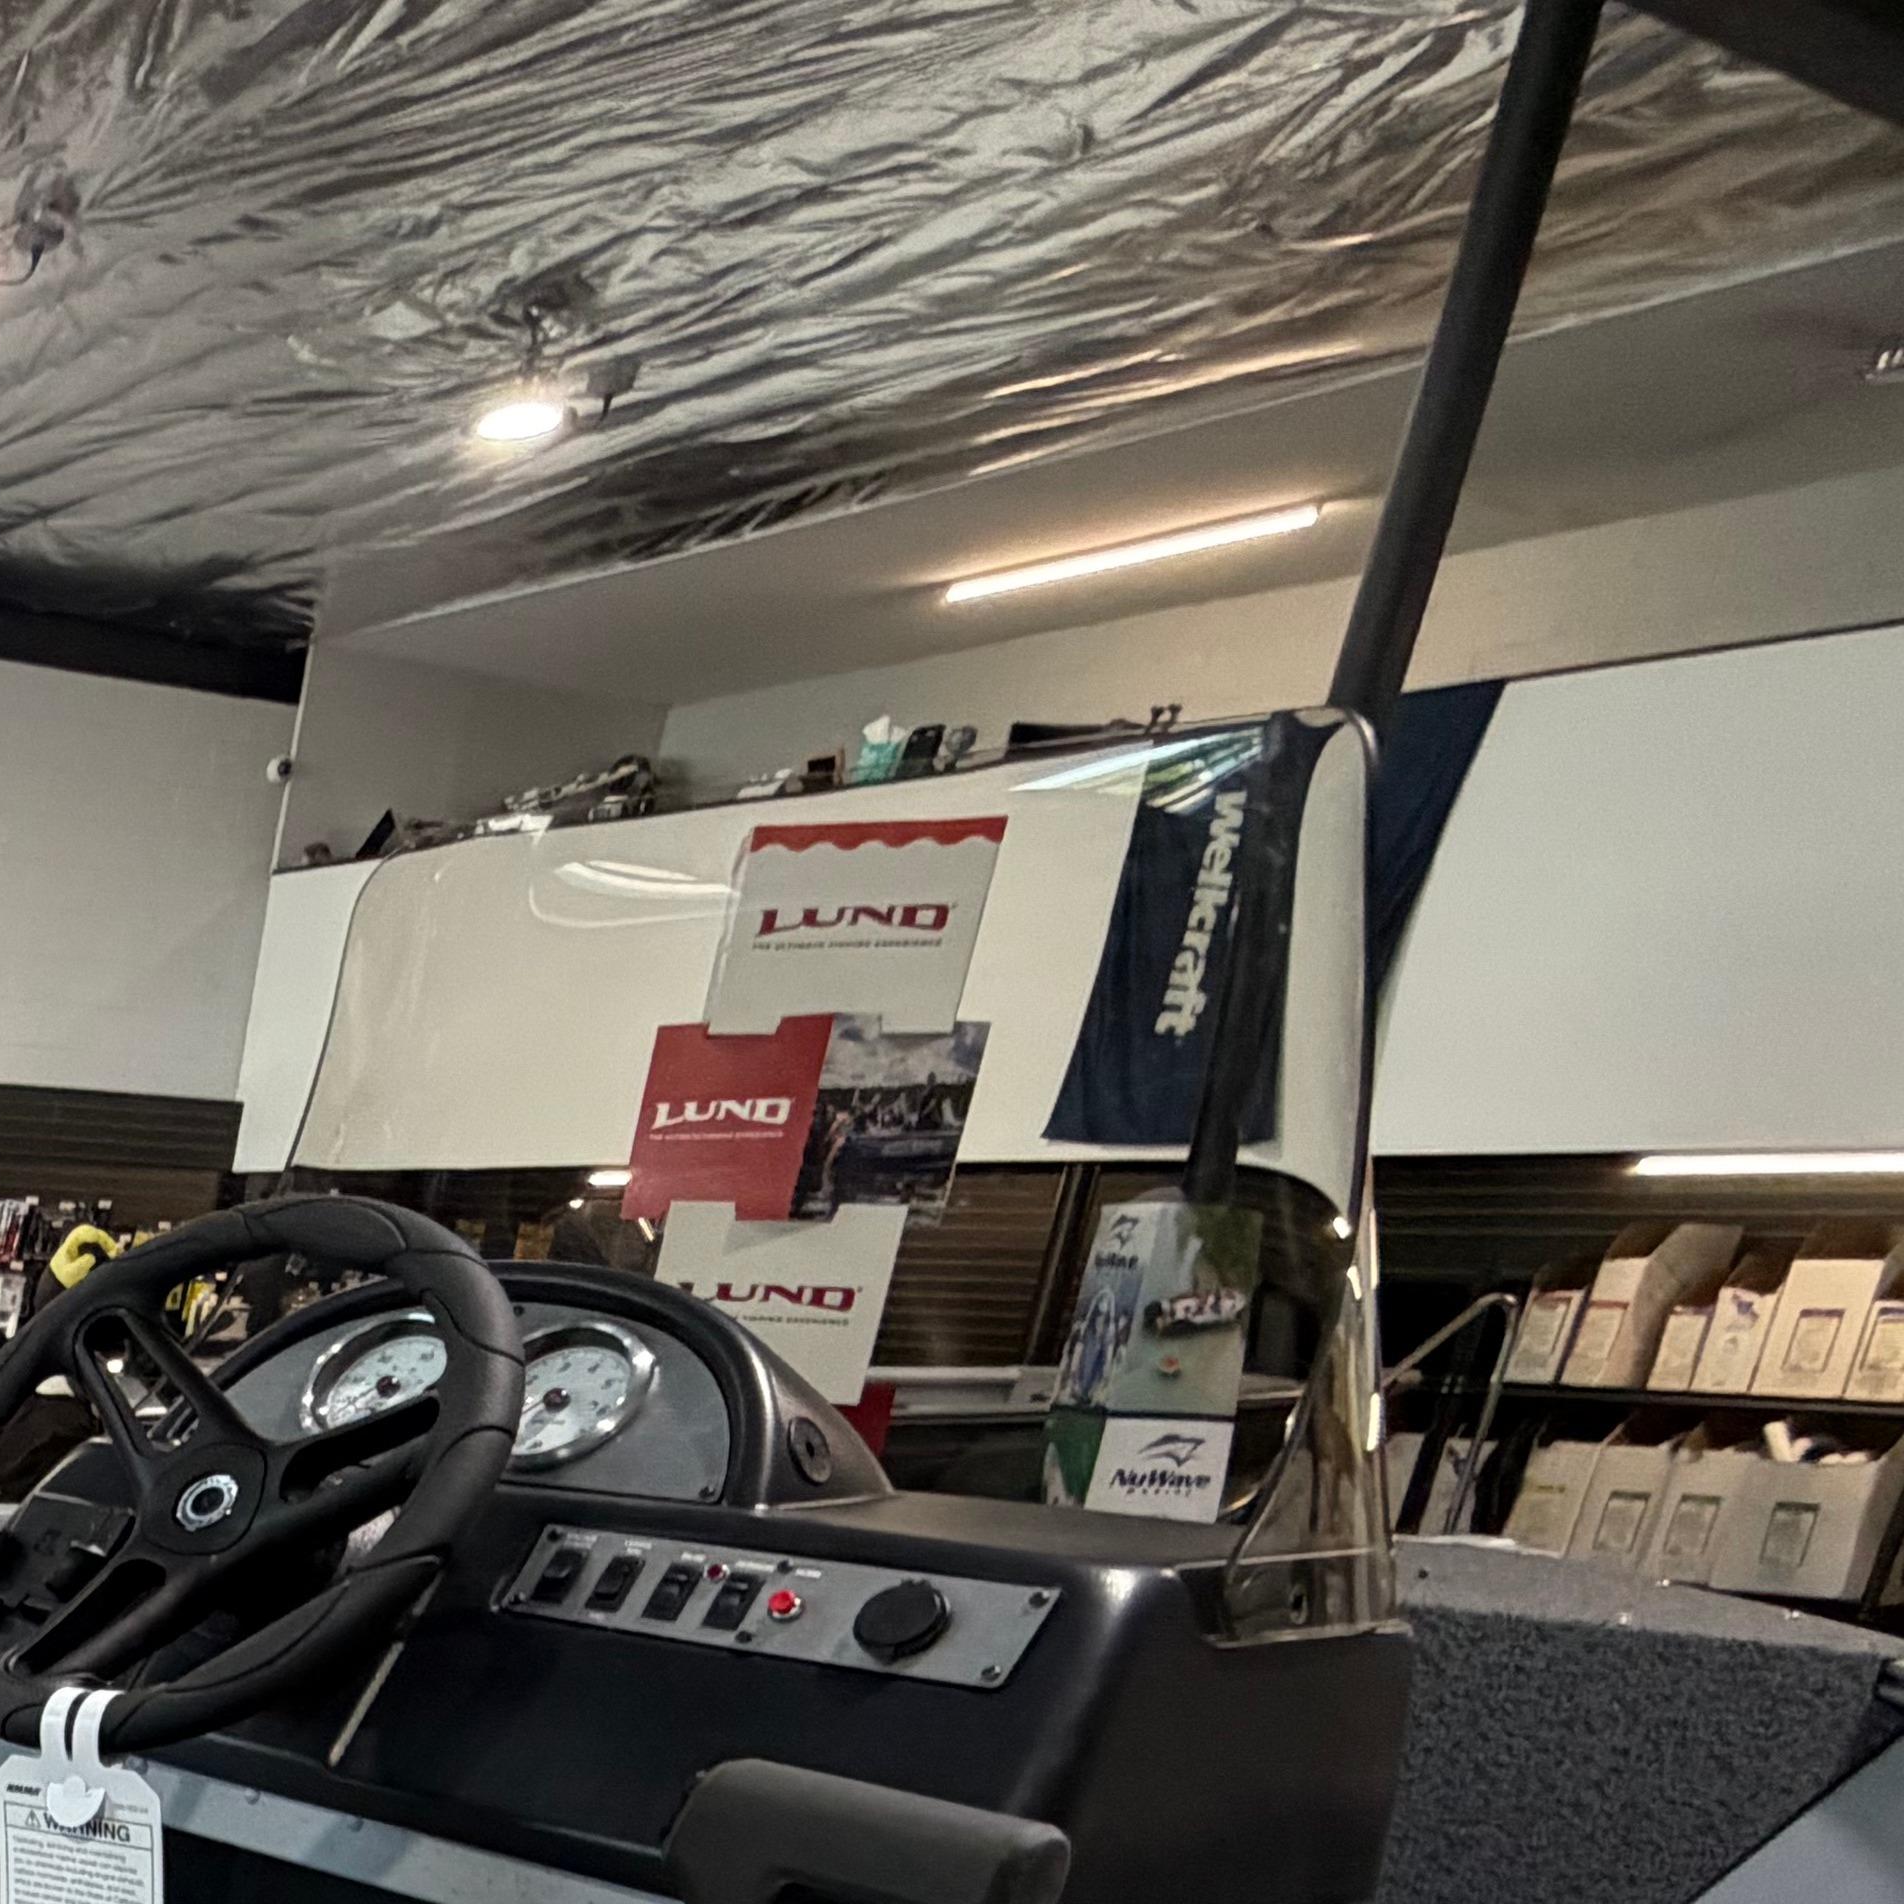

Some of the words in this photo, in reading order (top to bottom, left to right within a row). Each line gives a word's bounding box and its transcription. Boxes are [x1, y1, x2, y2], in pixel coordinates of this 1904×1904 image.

[755, 904, 951, 938] LUND
[1154, 790, 1247, 1036] Wellcraft
[651, 1098, 793, 1130] LUND
